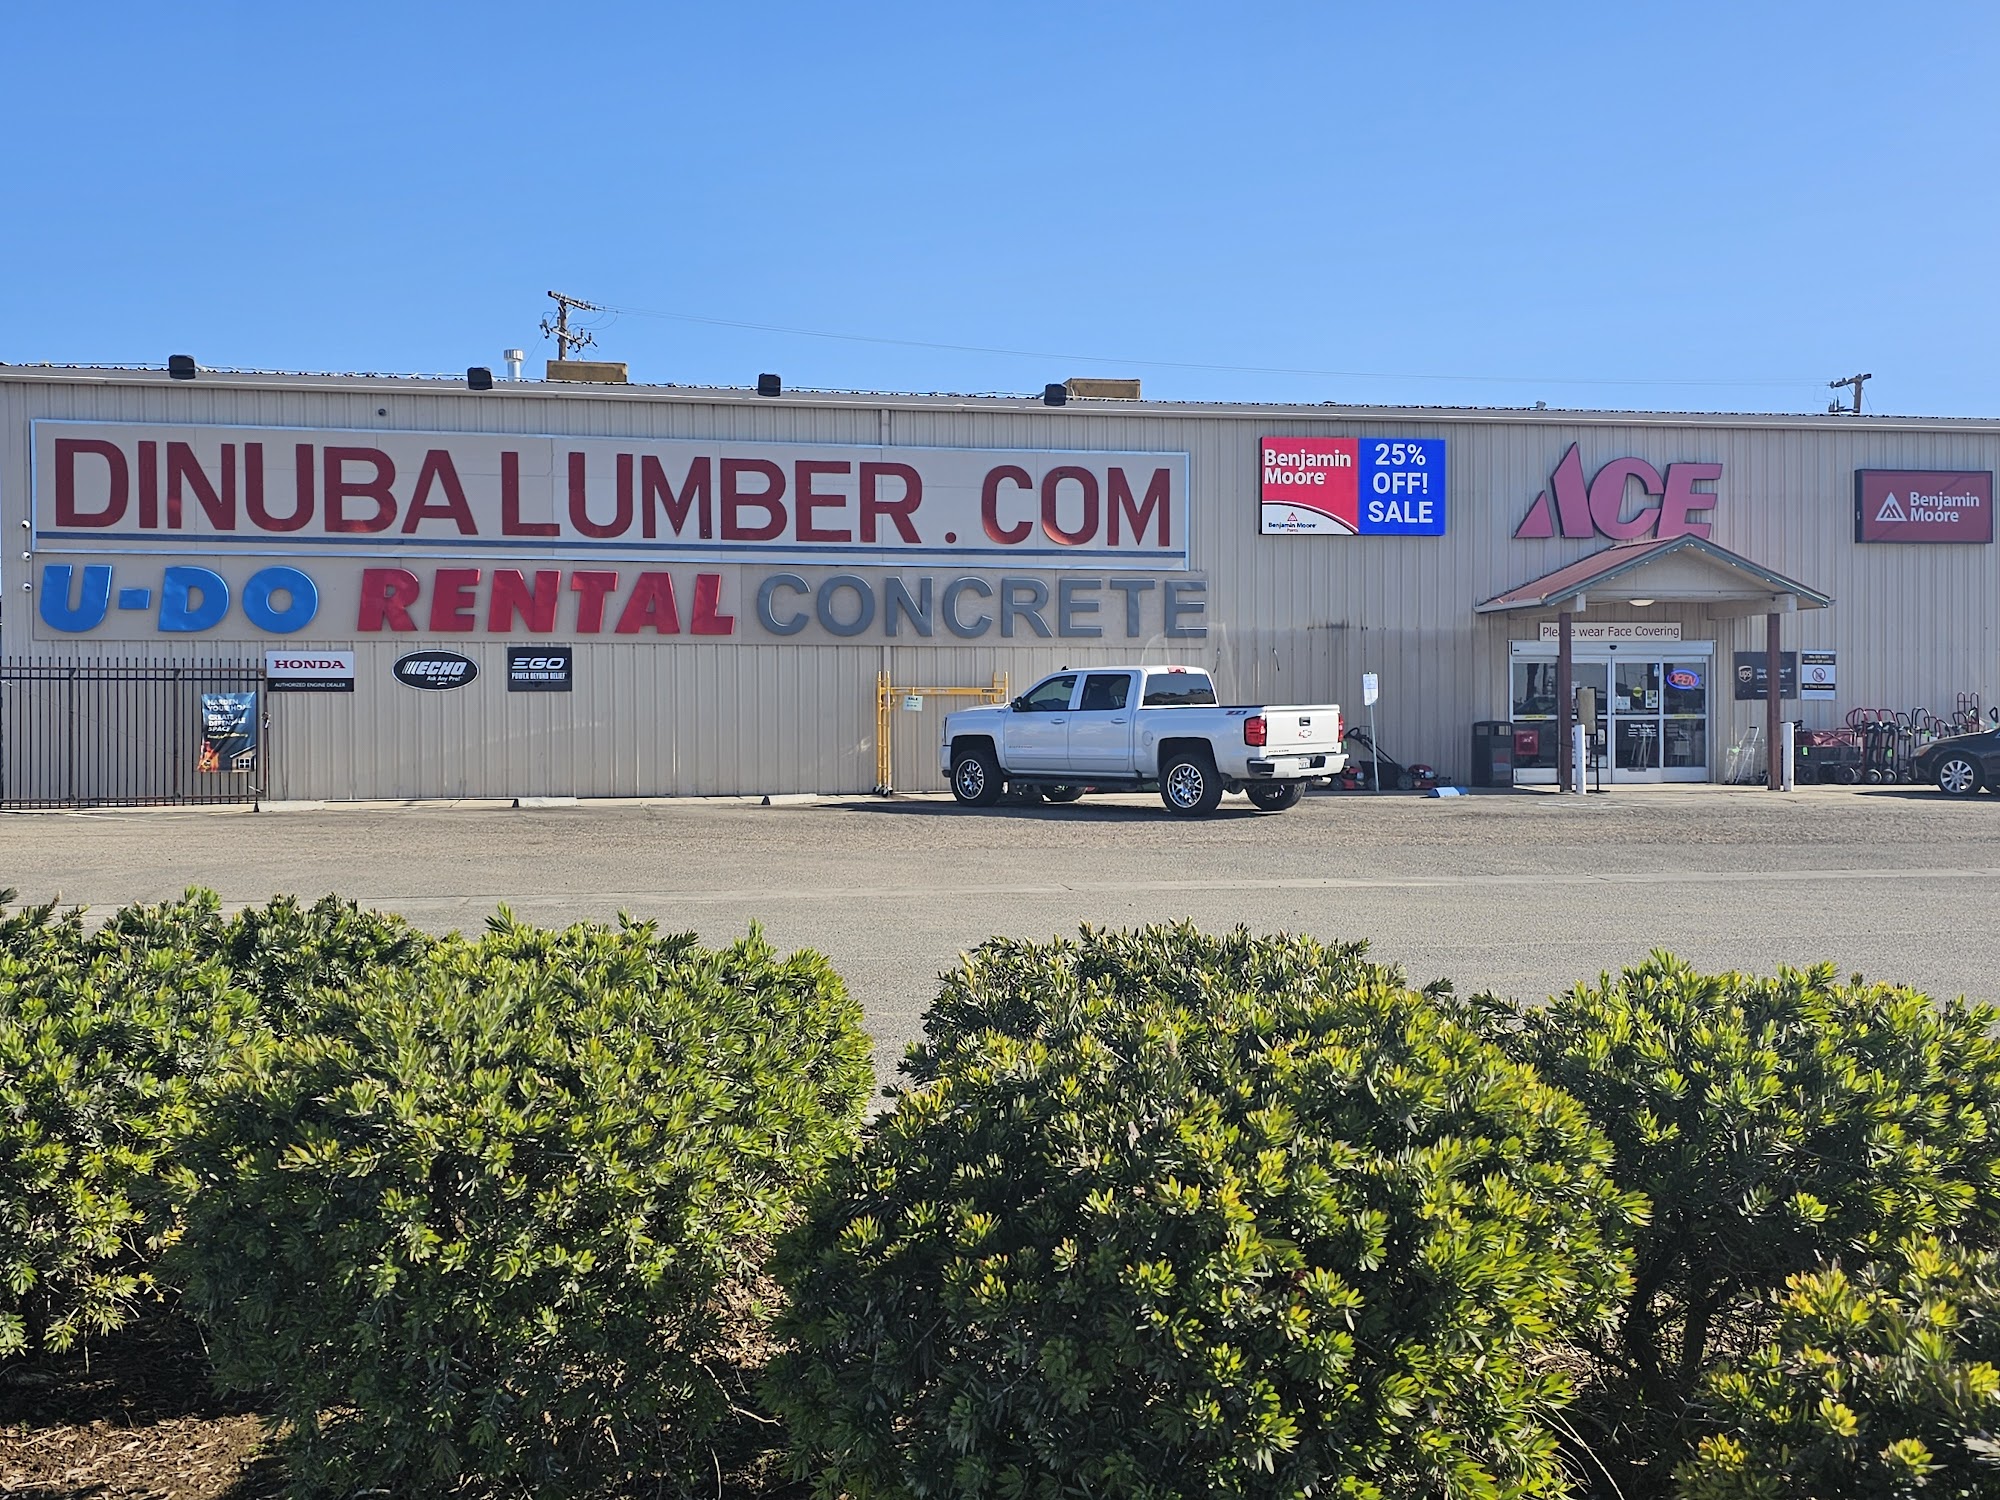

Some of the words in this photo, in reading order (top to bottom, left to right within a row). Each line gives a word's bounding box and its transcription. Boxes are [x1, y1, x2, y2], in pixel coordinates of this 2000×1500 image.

[1263, 449, 1351, 471] Benjamin
[1374, 443, 1426, 466] 25%
[1263, 467, 1326, 485] Moore
[1372, 472, 1429, 494] OFF!
[1513, 441, 1723, 541] ACE
[1909, 491, 1980, 510] Benjamin
[1367, 500, 1434, 523] SALE
[1909, 507, 1960, 523] Moore
[1268, 521, 1296, 530] Benjamin
[39, 564, 319, 634] U-DO
[357, 567, 736, 636] RENTAL
[756, 572, 1209, 639] CONCRETE
[1542, 626, 1576, 637] Plee
[1579, 628, 1605, 637] wear
[1608, 626, 1632, 637] Face
[1635, 625, 1680, 639] Covering
[274, 659, 346, 669] HONDA
[414, 661, 468, 675] ECHO
[511, 657, 565, 670] EGO
[511, 672, 530, 680] POWER
[1669, 671, 1696, 687] OPEN
